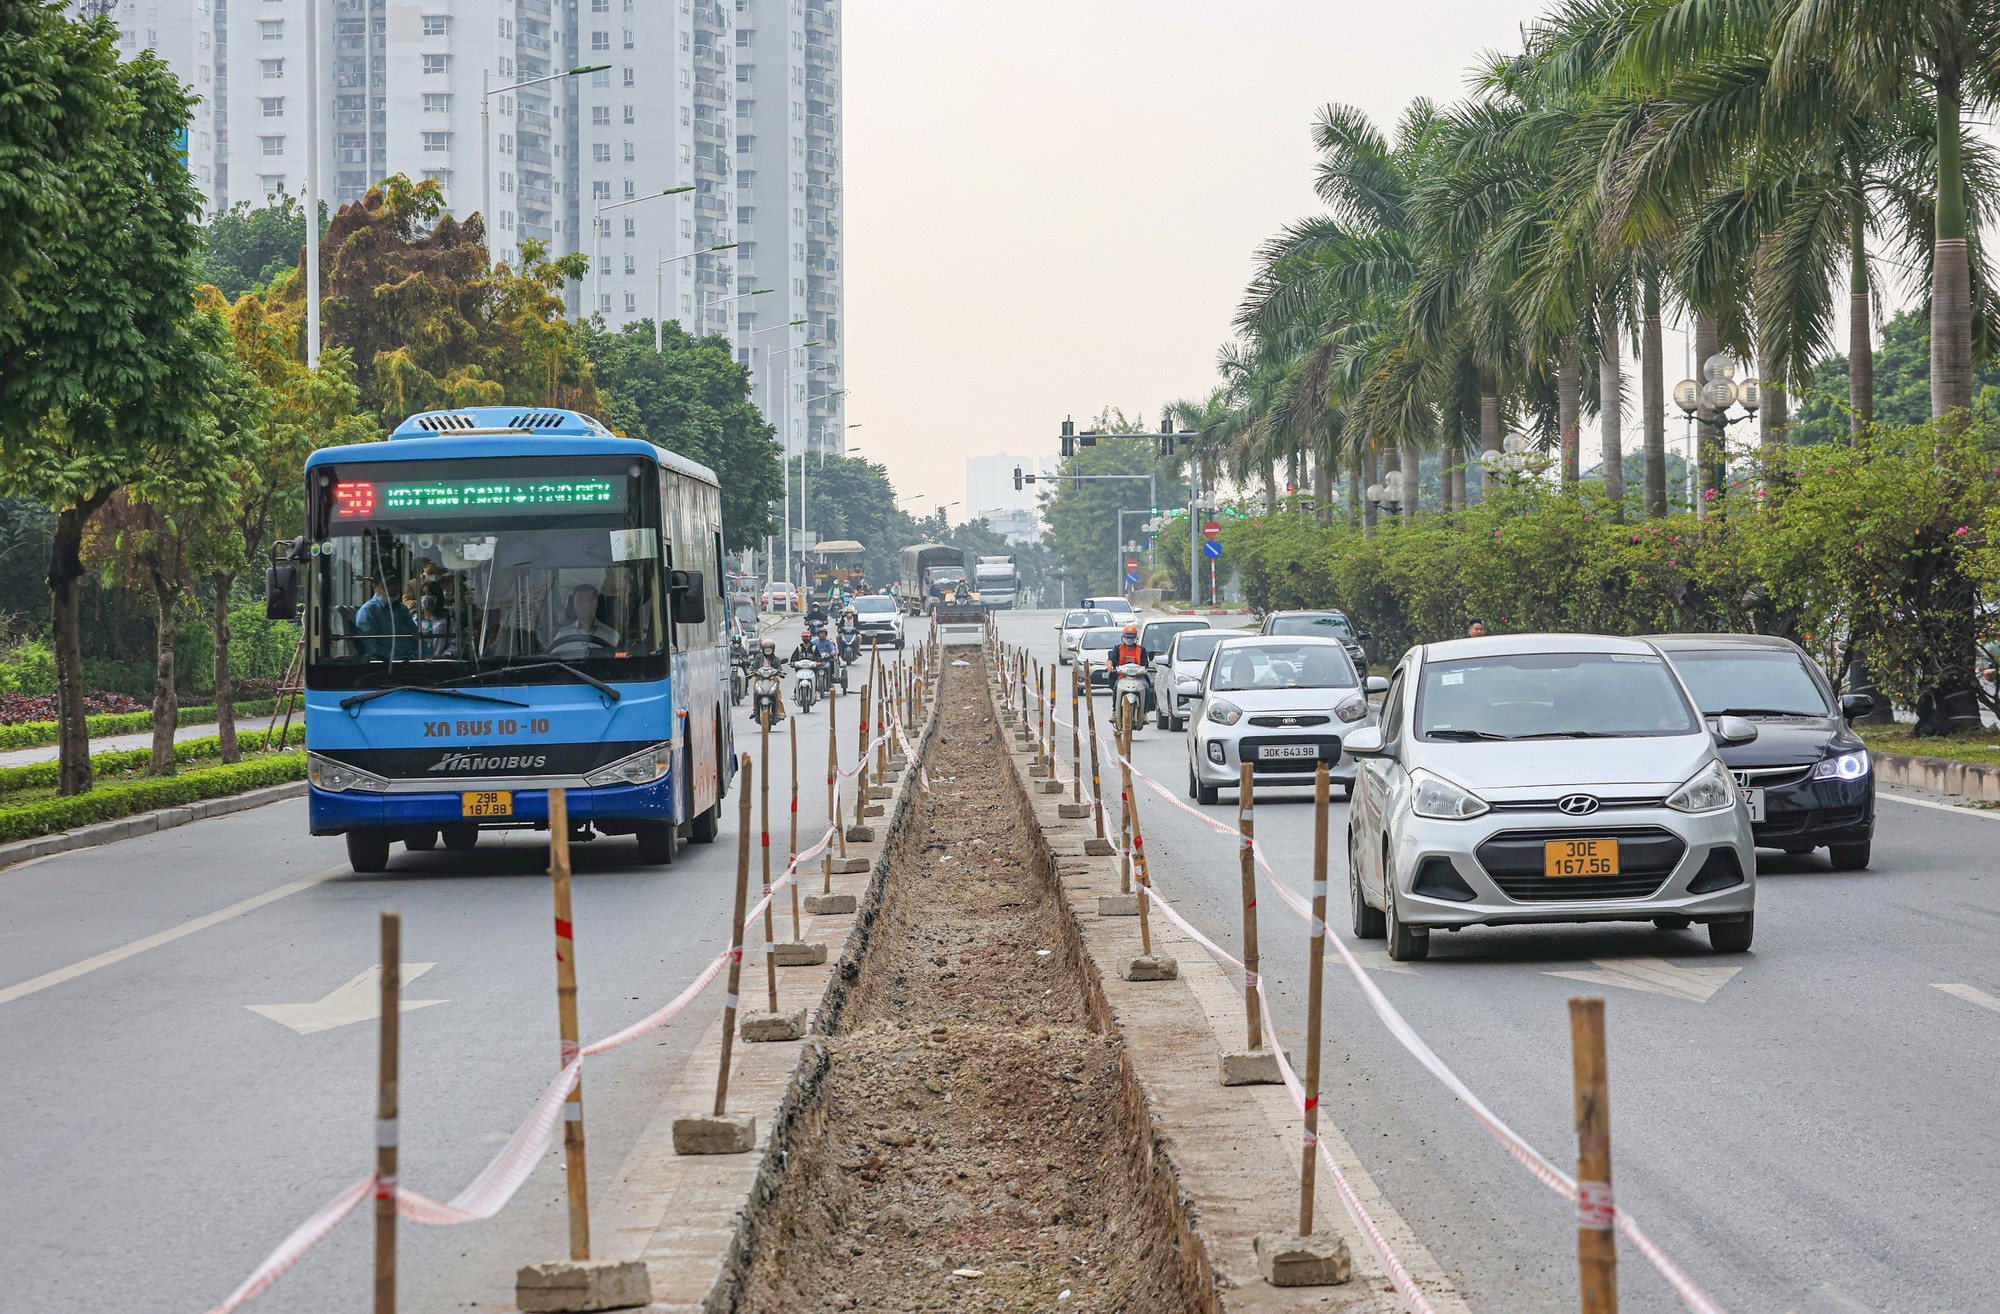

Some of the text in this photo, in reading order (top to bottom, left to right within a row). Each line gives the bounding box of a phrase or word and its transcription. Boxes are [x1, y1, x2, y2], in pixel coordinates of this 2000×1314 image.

[456, 720, 492, 736] BUS
[427, 753, 546, 771] HANOIBUS
[476, 792, 498, 804] 29B
[469, 804, 507, 816] 187.88
[1566, 841, 1598, 857] 30E
[1555, 858, 1611, 875] 167.56
